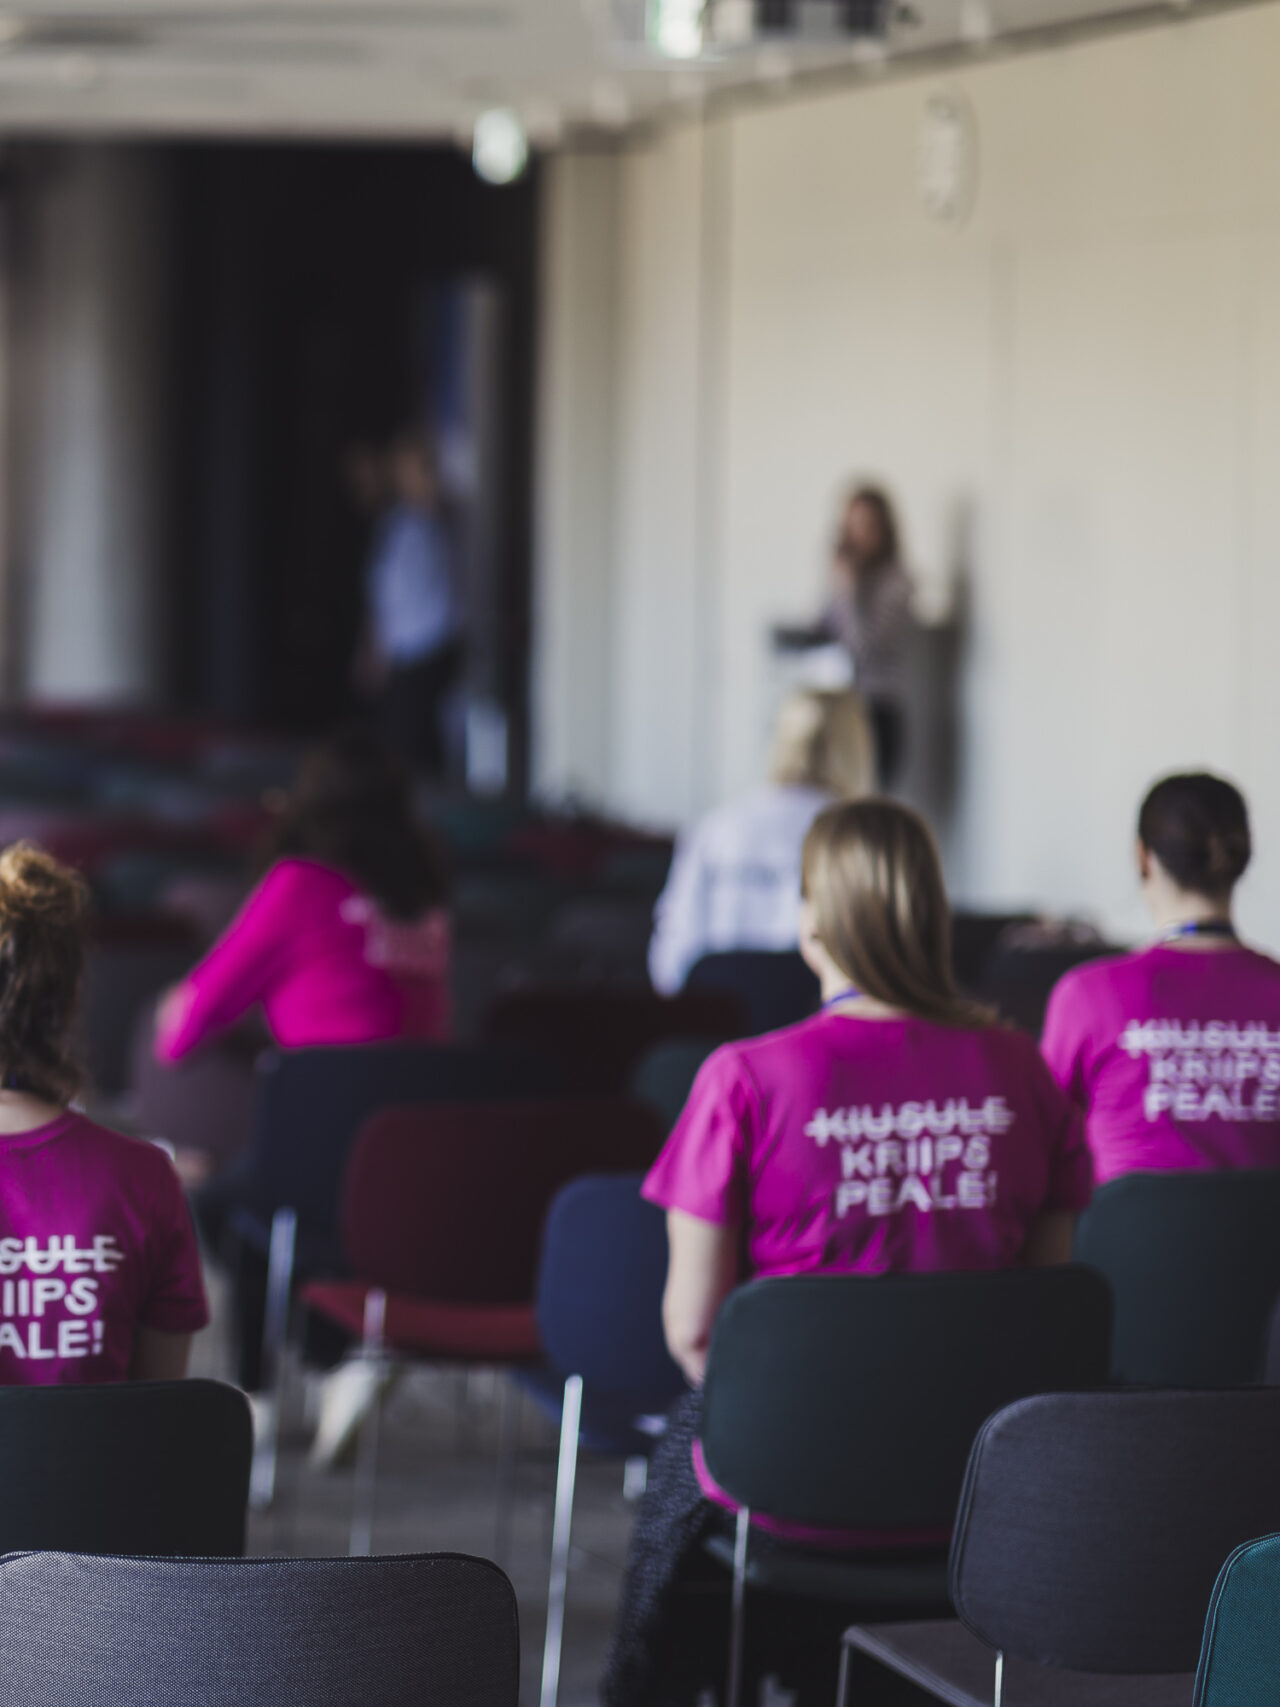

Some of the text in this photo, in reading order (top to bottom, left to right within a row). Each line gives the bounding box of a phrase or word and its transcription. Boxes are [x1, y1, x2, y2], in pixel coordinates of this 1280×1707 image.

[1124, 1018, 1280, 1060] KIUSUL
[841, 1133, 991, 1180] KRIIPS
[835, 1170, 998, 1220] PEALE!
